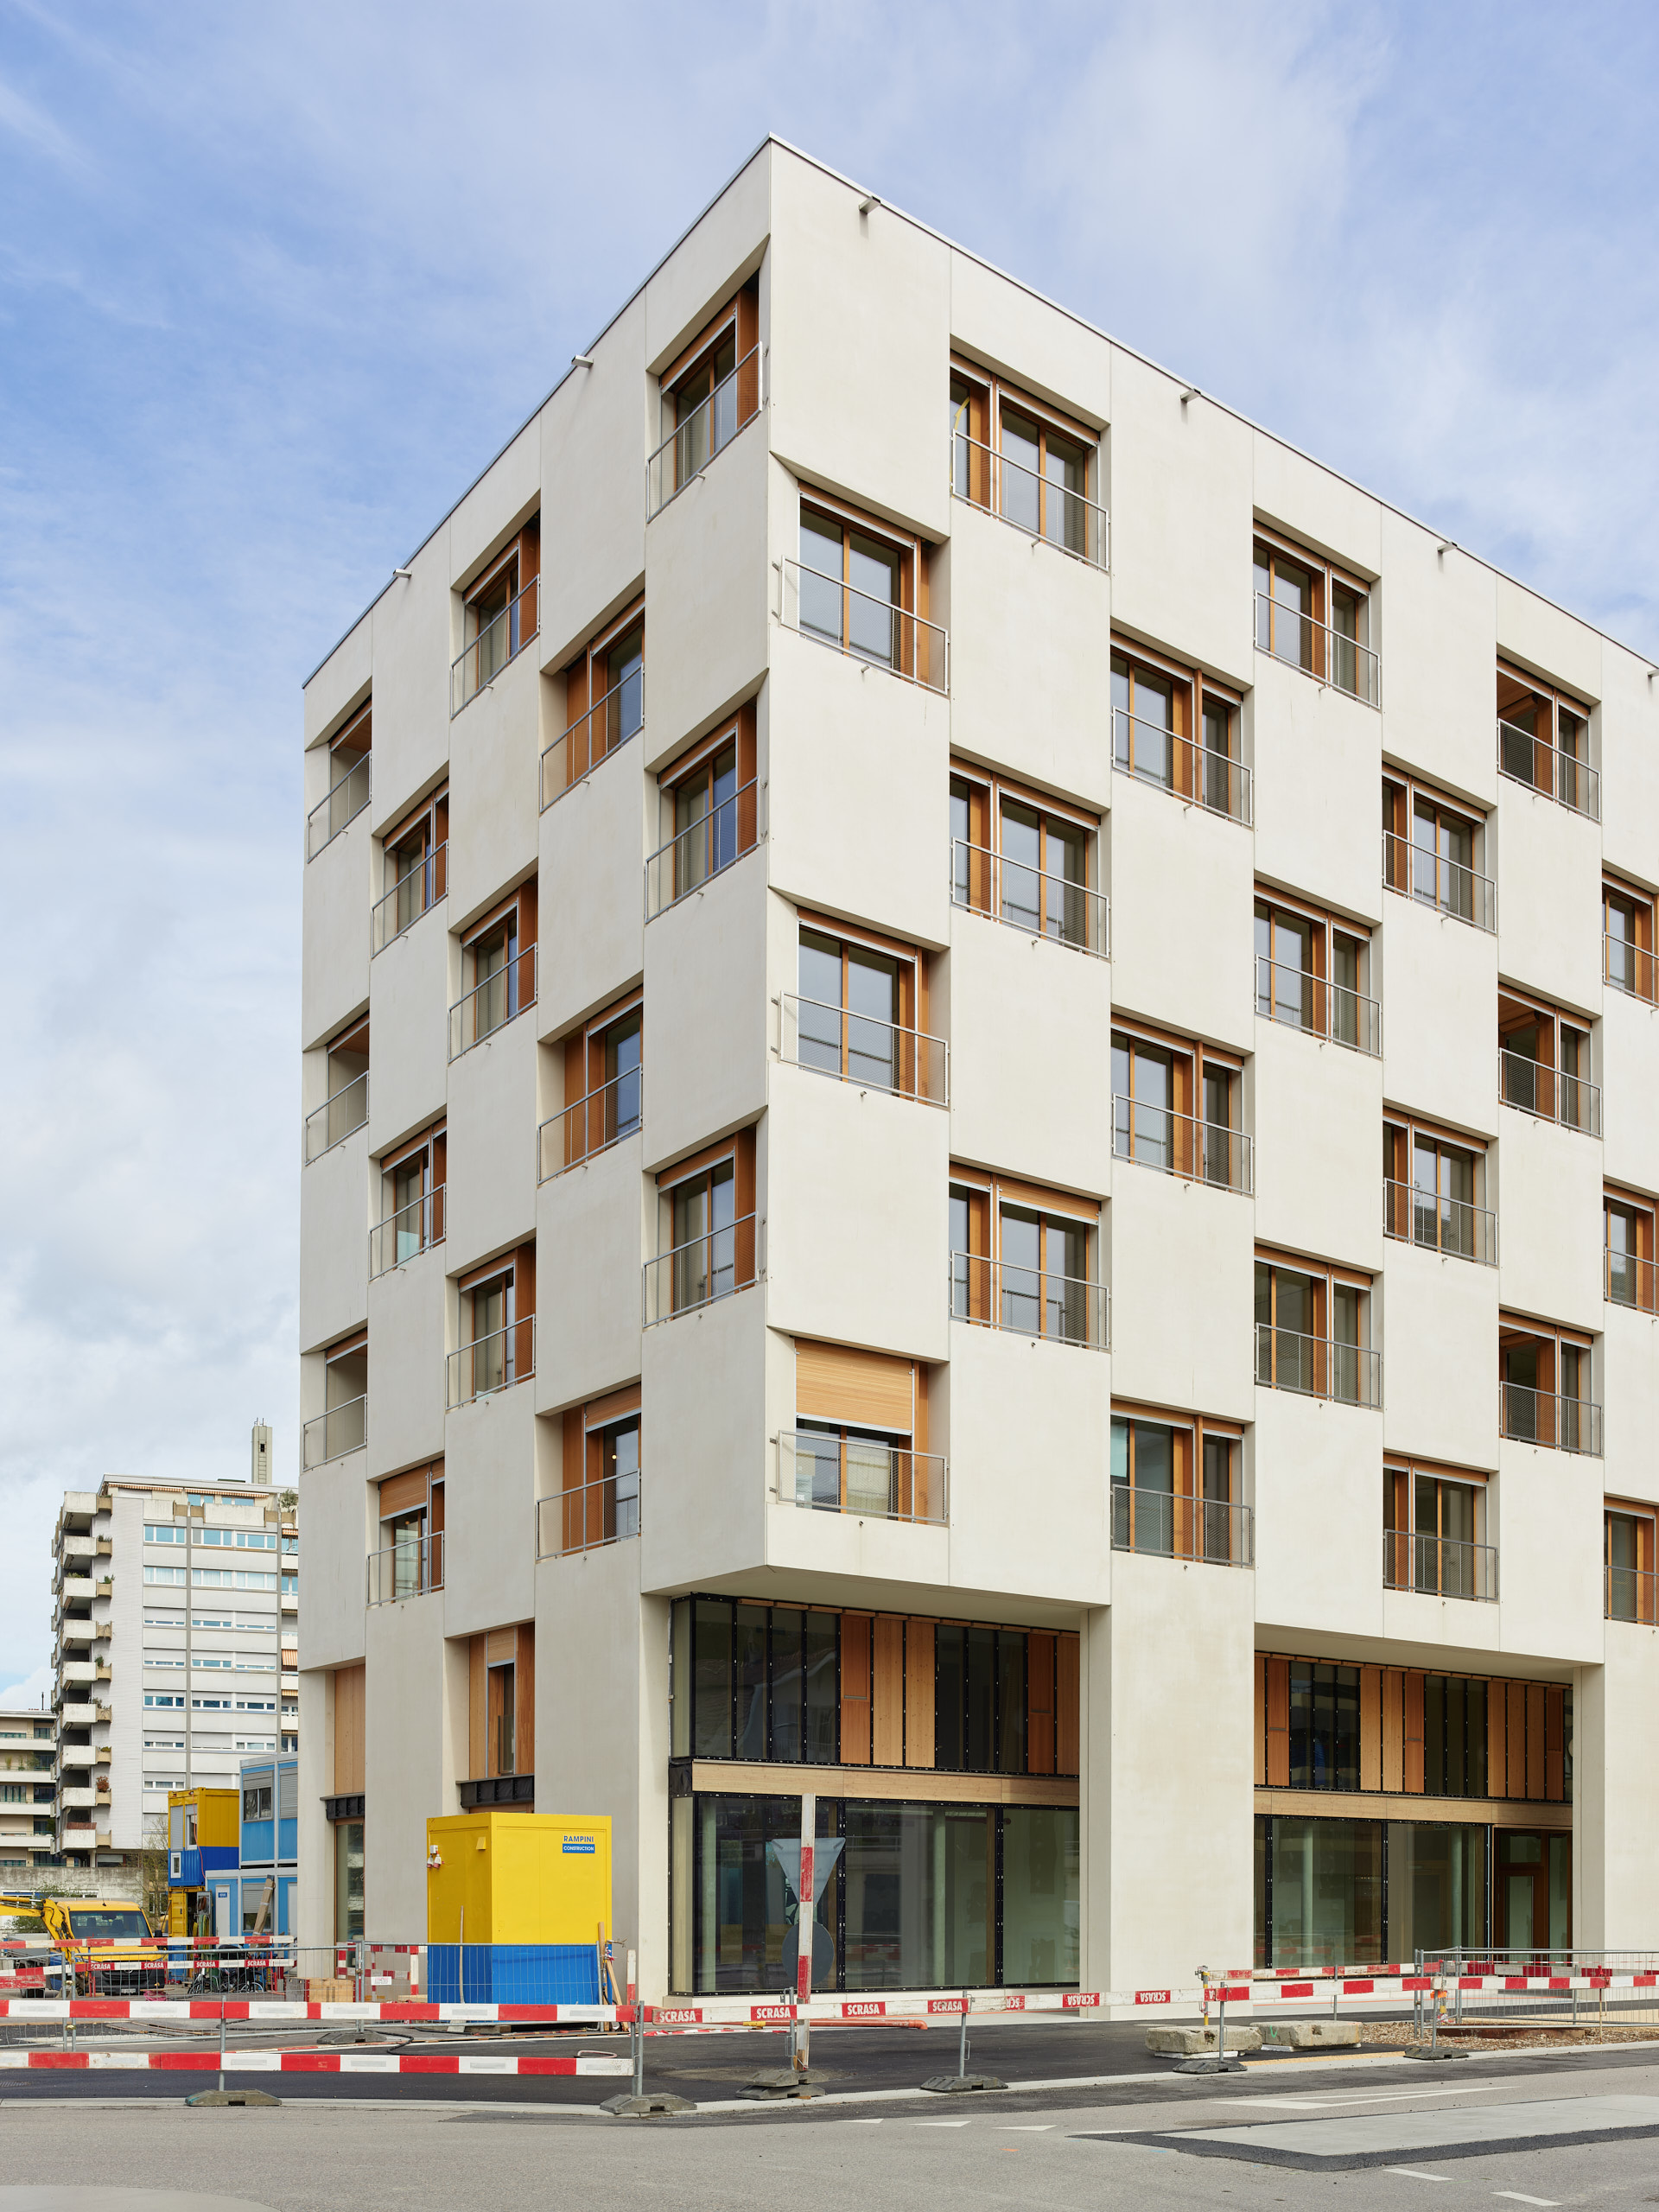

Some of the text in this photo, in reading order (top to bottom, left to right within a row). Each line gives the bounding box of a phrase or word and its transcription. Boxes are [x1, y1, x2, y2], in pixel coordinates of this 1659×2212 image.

[1067, 1994, 1095, 2005] SCRASA
[1140, 1992, 1166, 2003] SCRASA
[847, 2003, 880, 2016] SCRASA
[932, 1999, 963, 2012] SCRASA
[659, 2010, 696, 2023] SCRASA
[756, 2006, 791, 2019] SCRASA
